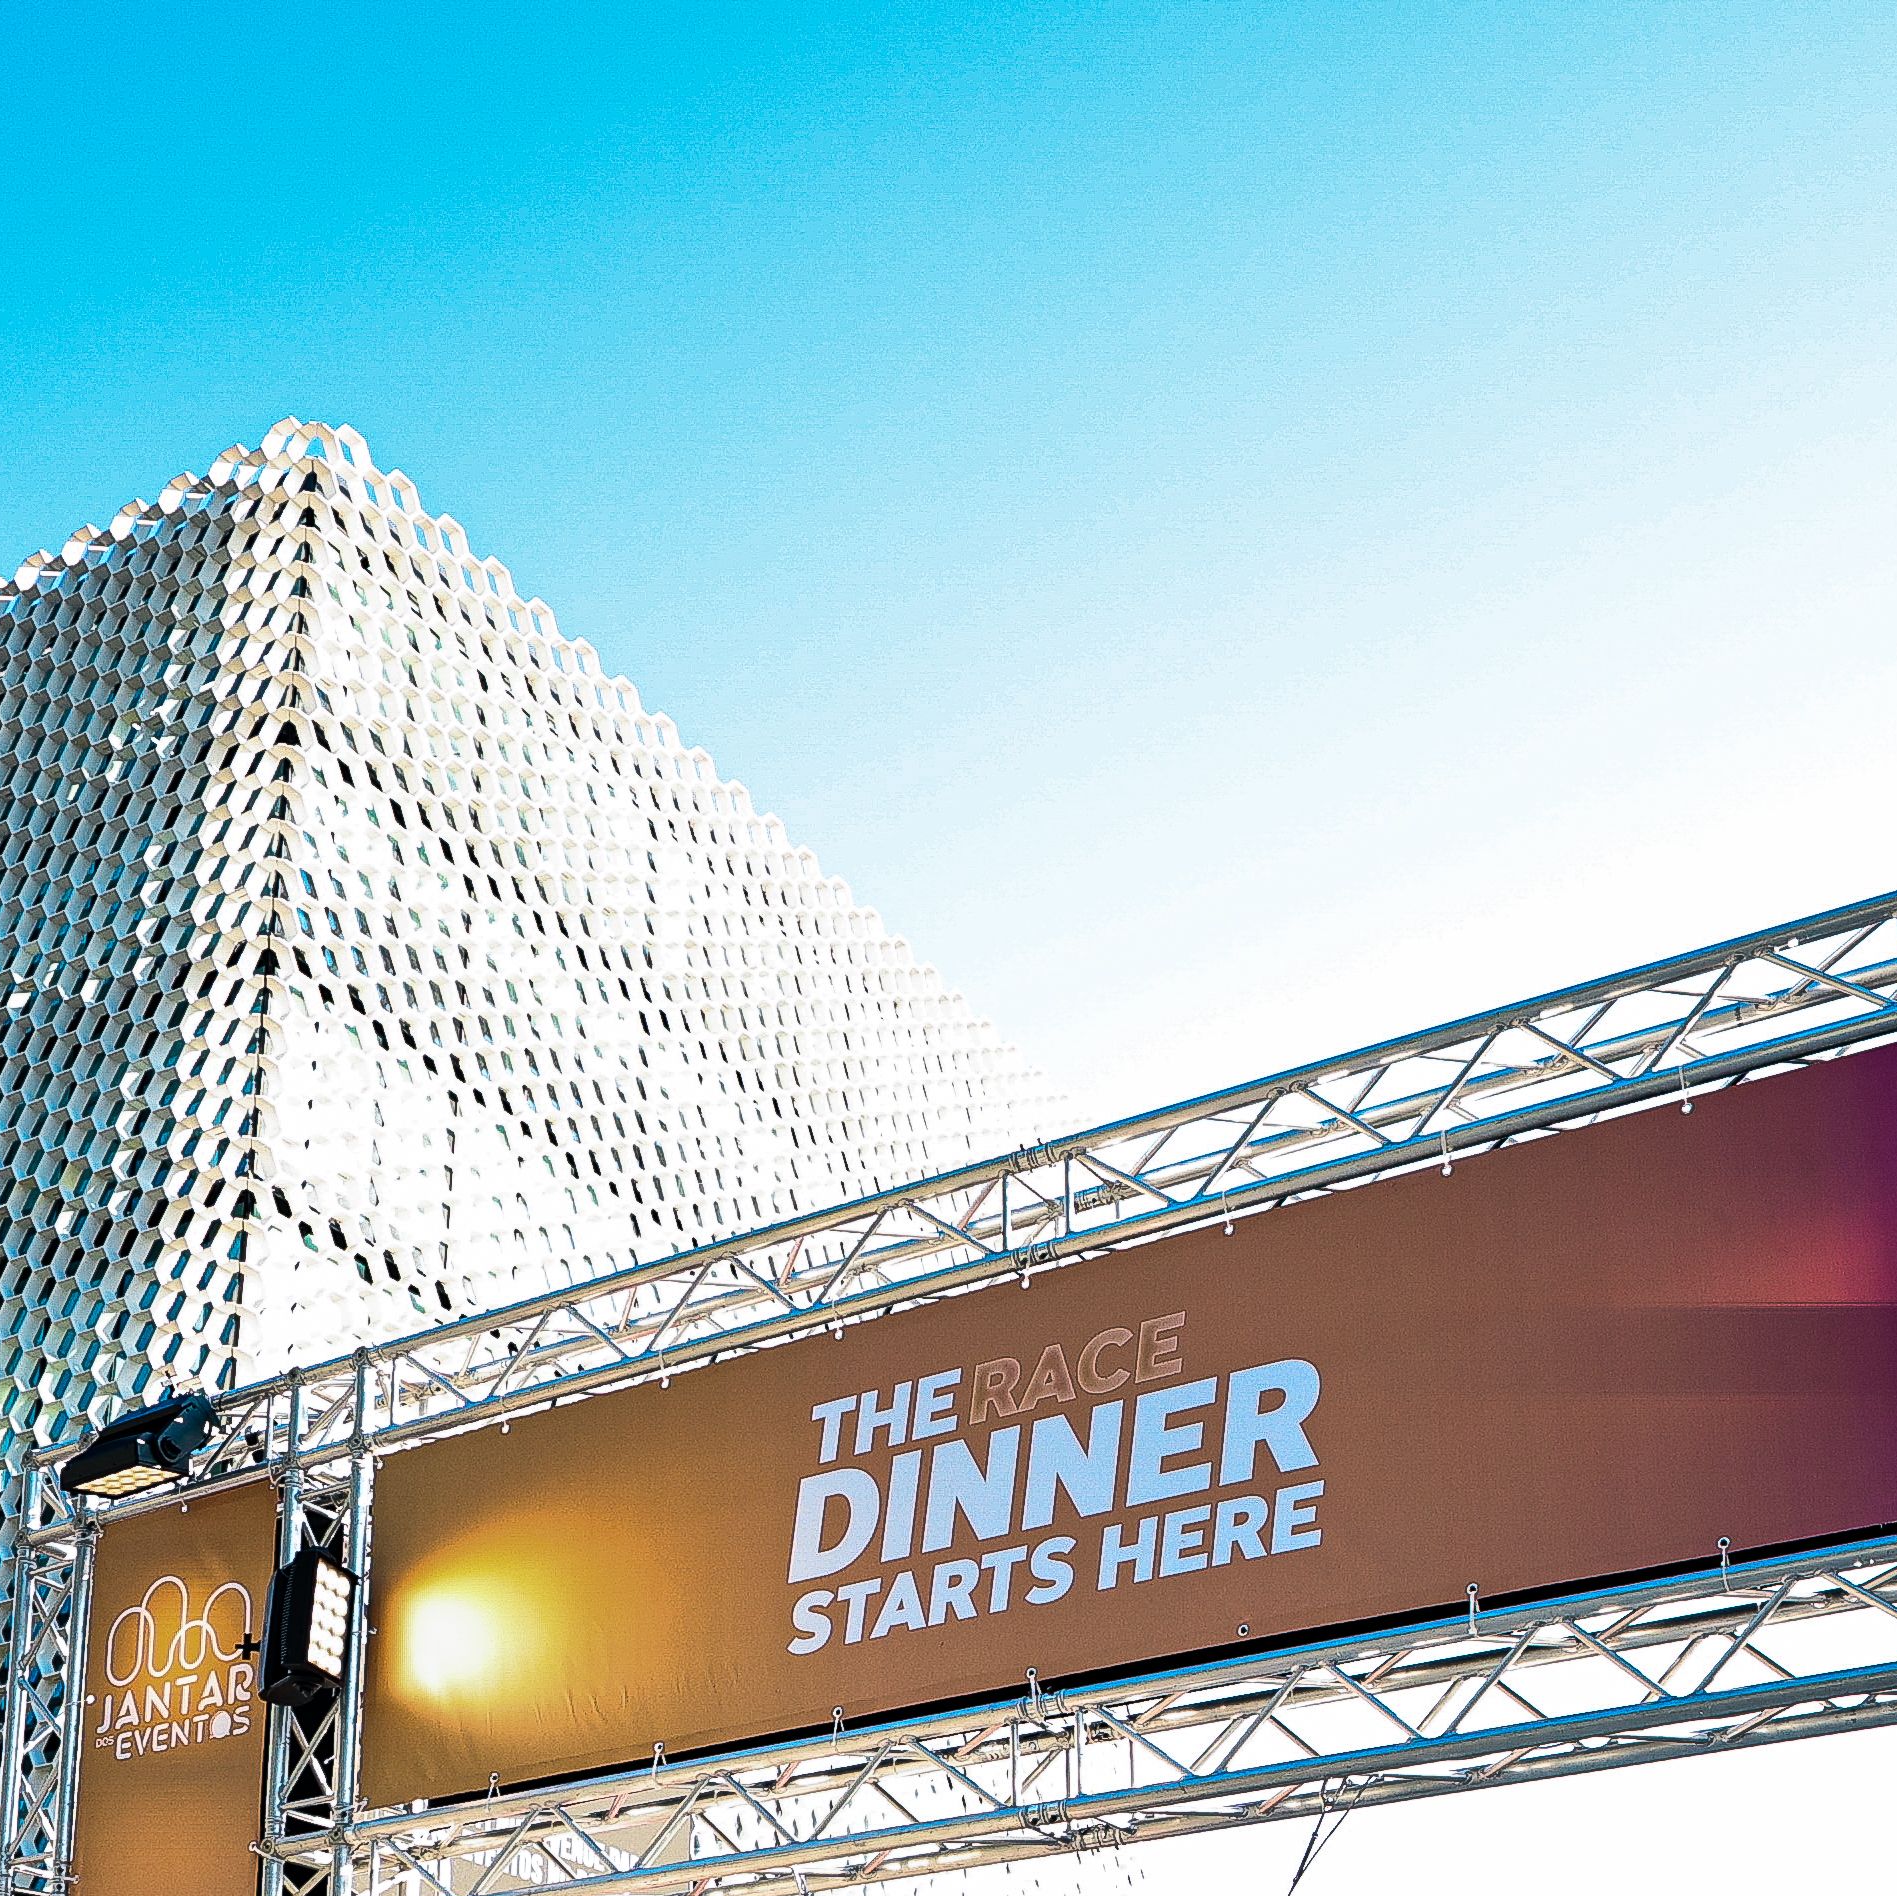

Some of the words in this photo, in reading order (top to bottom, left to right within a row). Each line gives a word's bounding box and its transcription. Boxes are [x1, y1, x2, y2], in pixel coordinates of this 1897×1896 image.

[810, 1366, 963, 1464] THE
[968, 1310, 1187, 1425] RACE
[786, 1358, 1322, 1585] DINNER
[786, 1536, 1078, 1656] STARTS
[1096, 1480, 1327, 1593] HERE
[95, 1663, 254, 1735] JANTAR
[114, 1704, 251, 1760] EVENTOS
